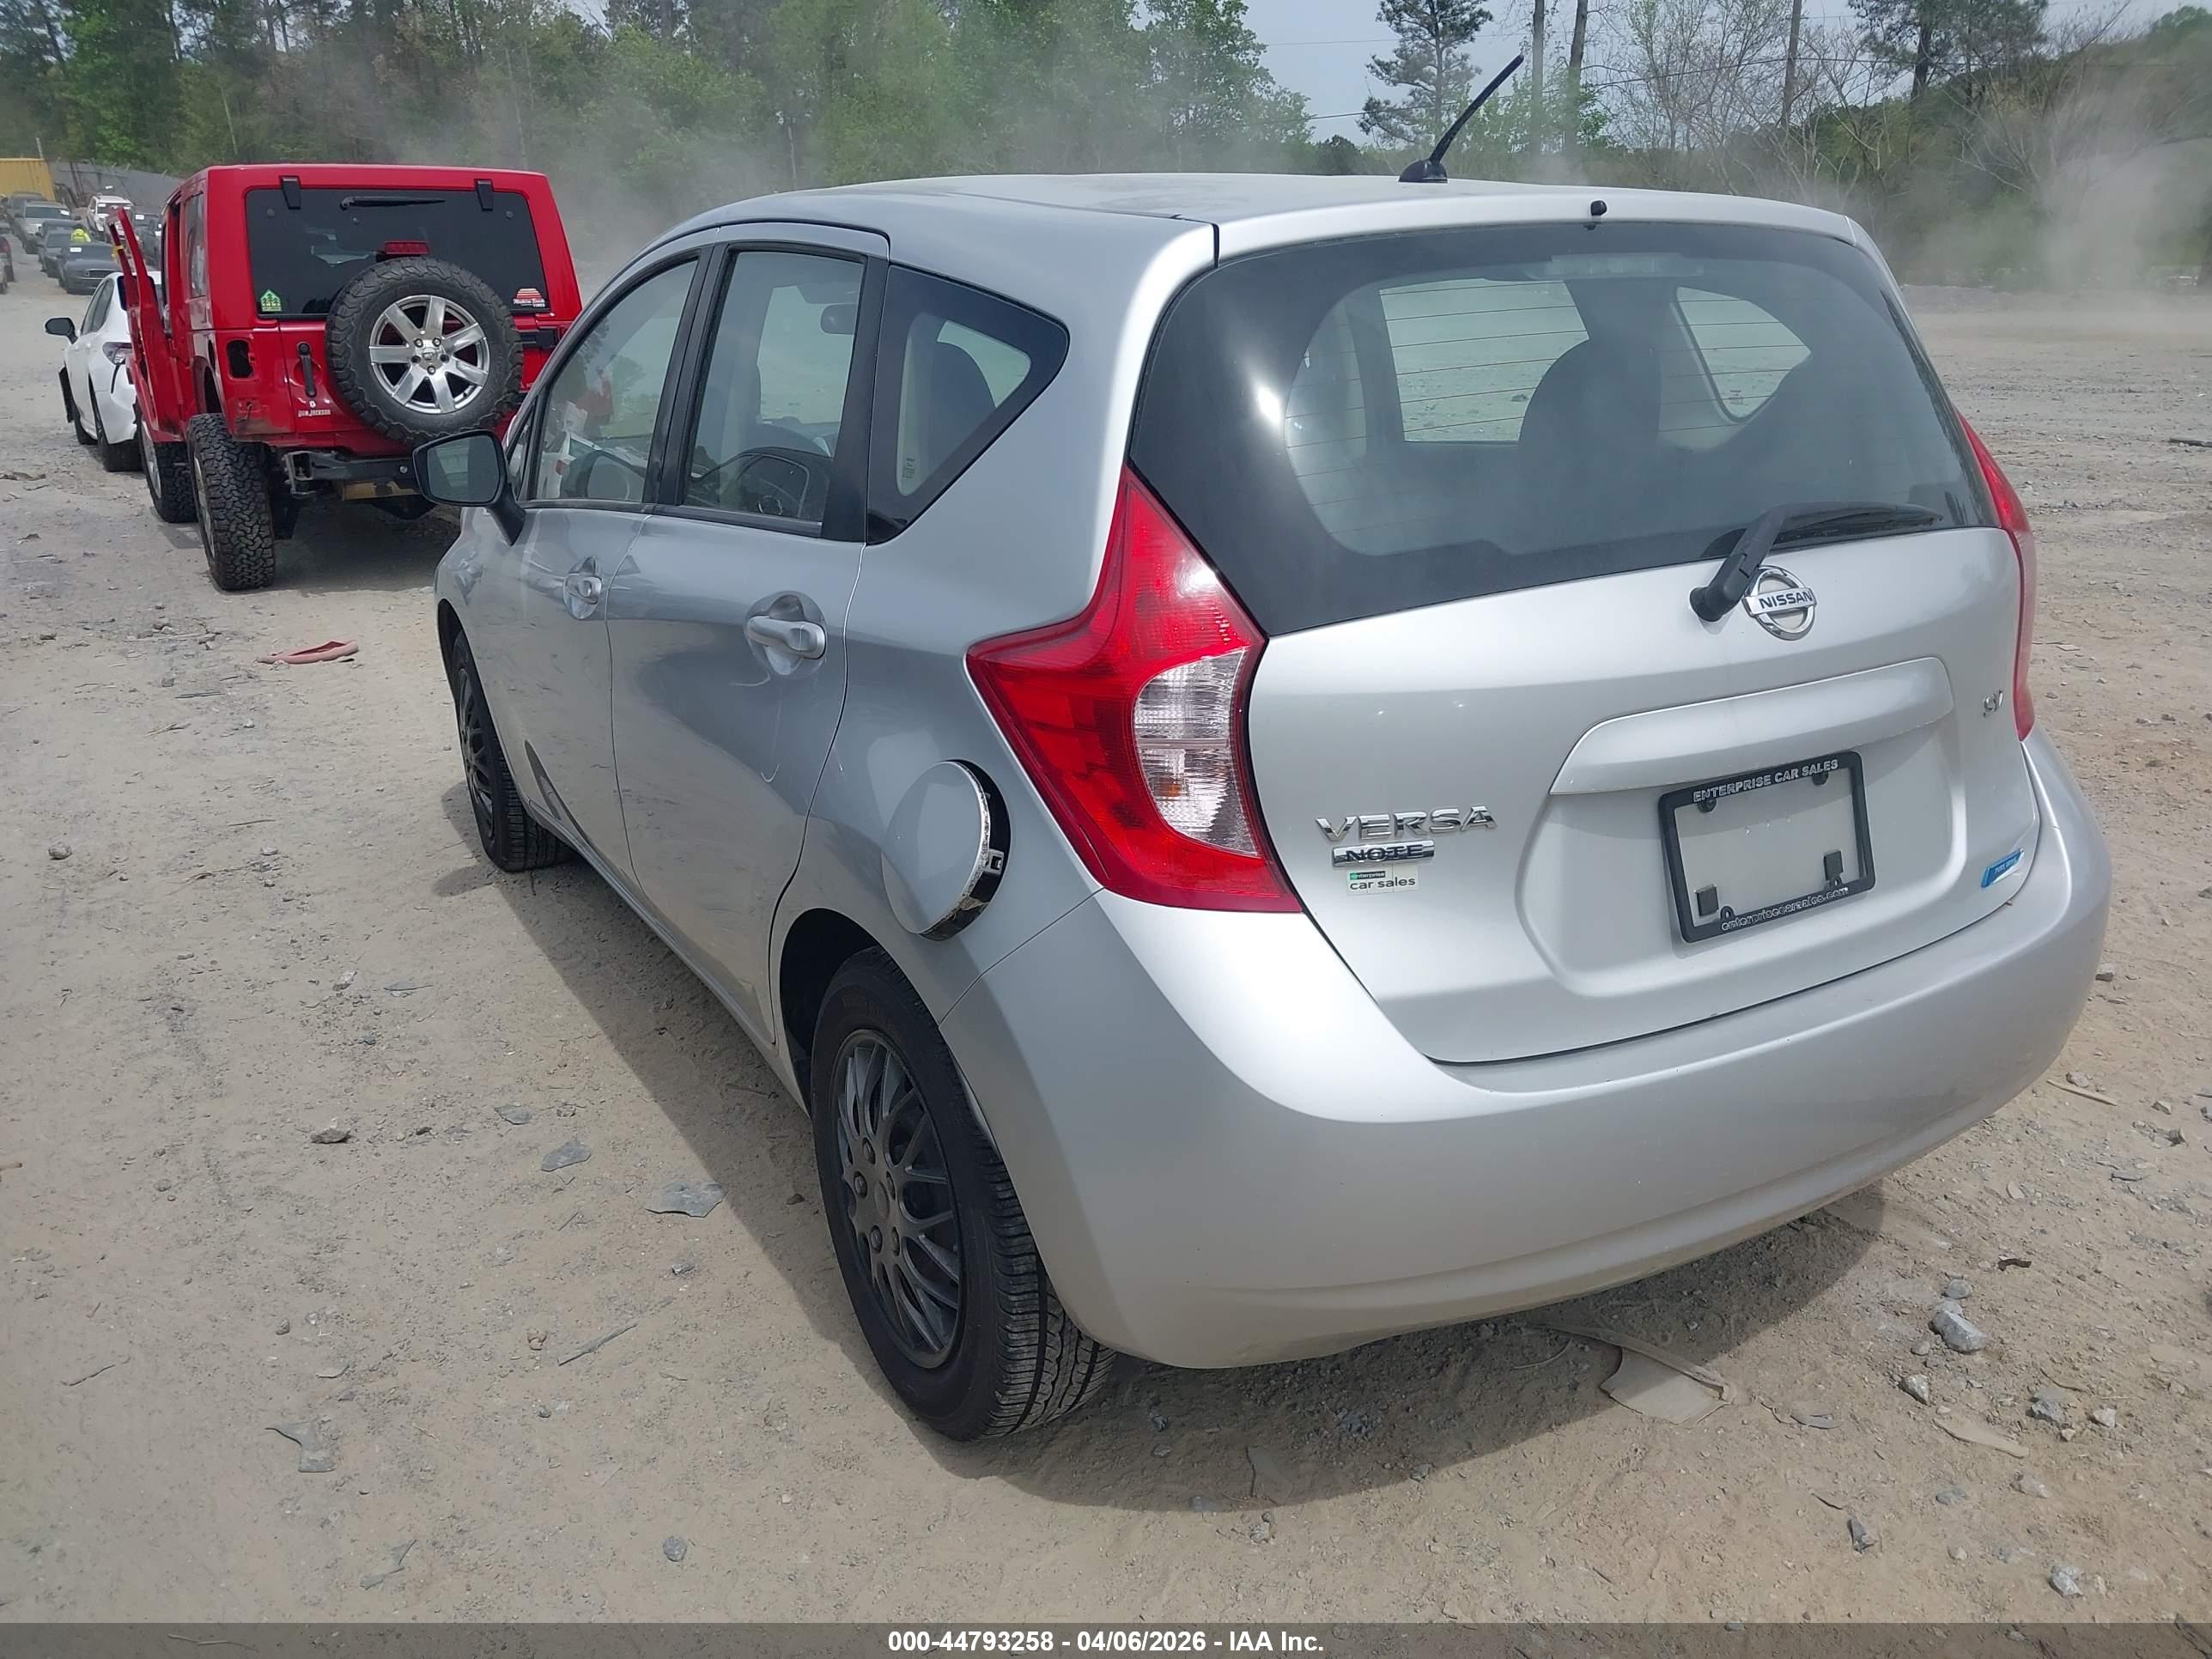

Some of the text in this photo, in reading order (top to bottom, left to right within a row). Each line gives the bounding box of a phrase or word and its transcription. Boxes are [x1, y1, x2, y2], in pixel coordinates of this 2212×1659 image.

[1758, 590, 1814, 610] NISSAN
[1692, 759, 1839, 803] ENTERPRISE CAR SALES
[1315, 805, 1498, 842] VERSA
[1345, 843, 1425, 862] NOTE
[1350, 877, 1416, 890] car sales
